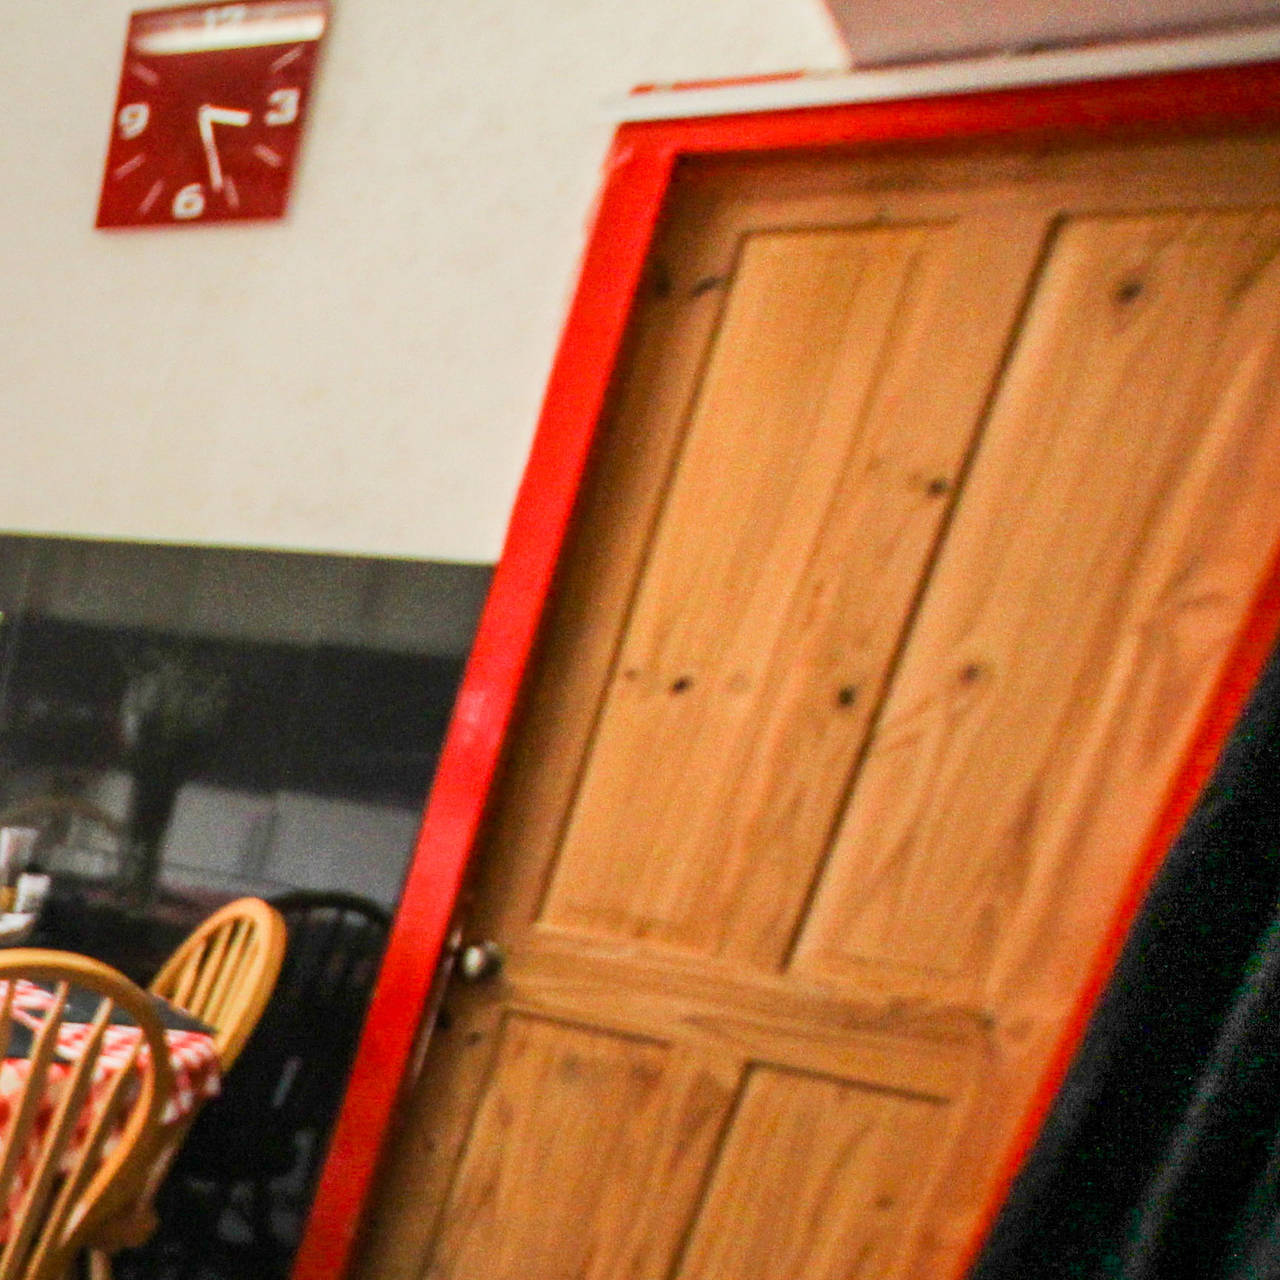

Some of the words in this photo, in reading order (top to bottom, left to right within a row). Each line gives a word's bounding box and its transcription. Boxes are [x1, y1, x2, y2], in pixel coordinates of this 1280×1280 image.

[118, 102, 151, 140] 9
[264, 87, 301, 127] 3
[172, 182, 205, 220] 6
